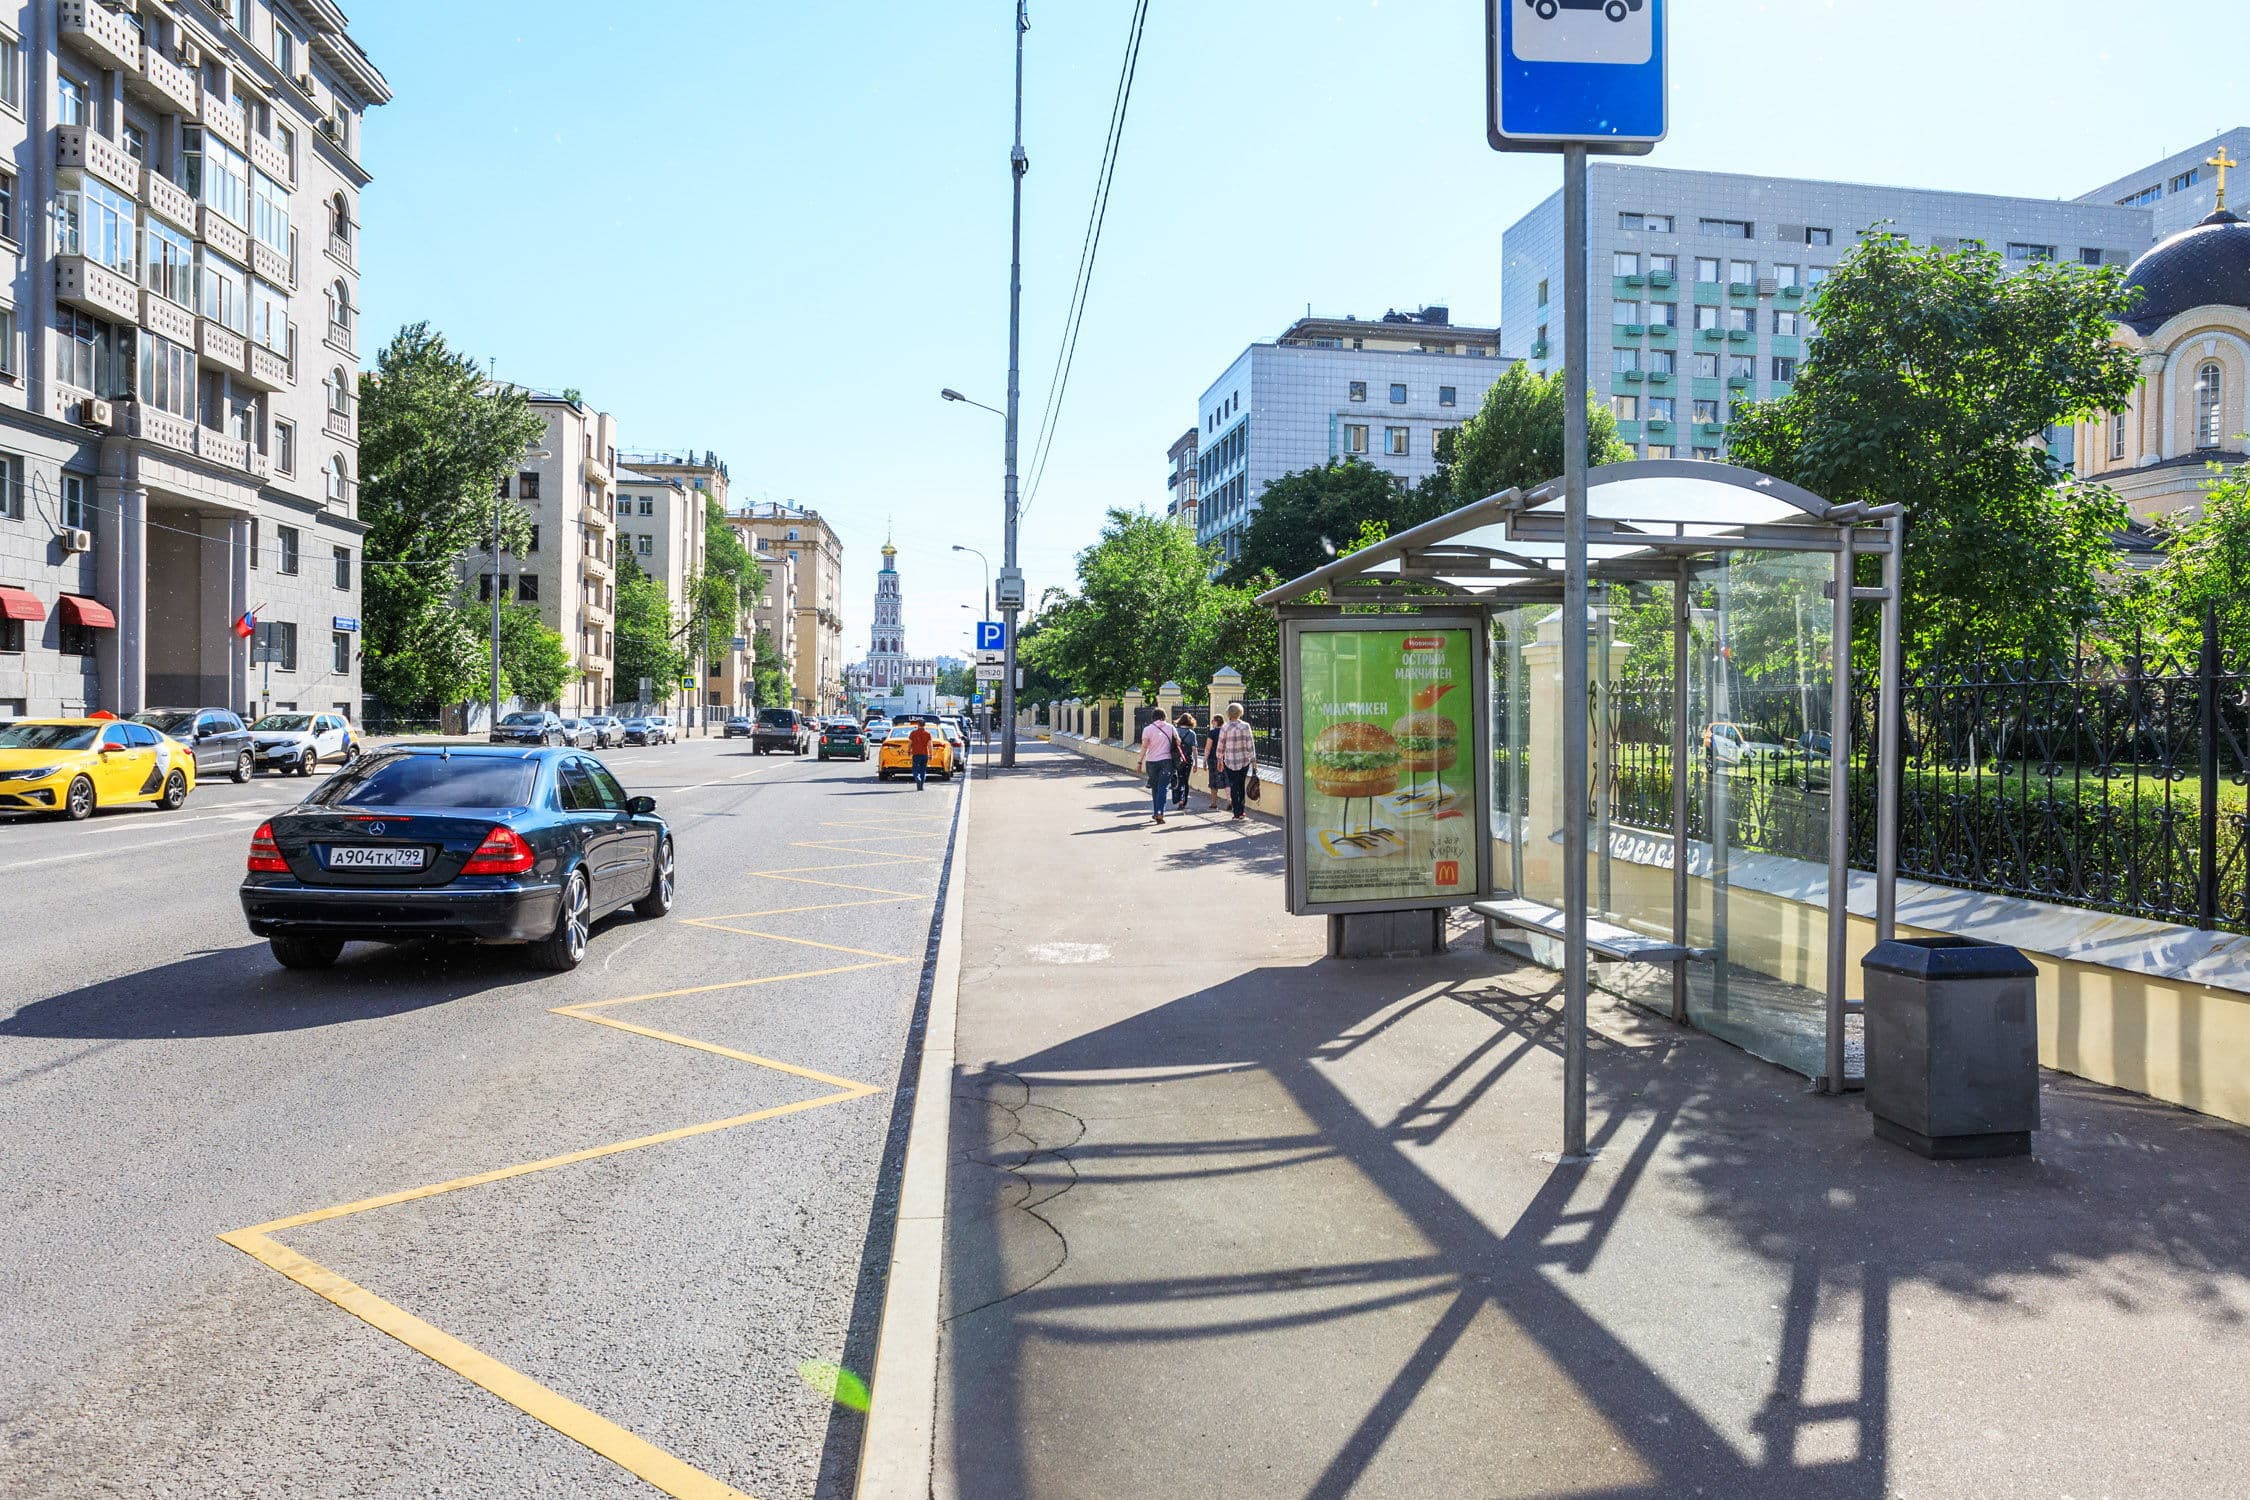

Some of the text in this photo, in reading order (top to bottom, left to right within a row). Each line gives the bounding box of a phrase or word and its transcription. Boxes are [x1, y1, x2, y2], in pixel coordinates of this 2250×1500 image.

[984, 625, 1000, 647] P
[1402, 651, 1445, 665] ОСТРЫЙ
[1395, 667, 1452, 680] МАКЧИКЕН
[1322, 701, 1388, 716] МАКЧИКЕН
[397, 850, 420, 861] 799
